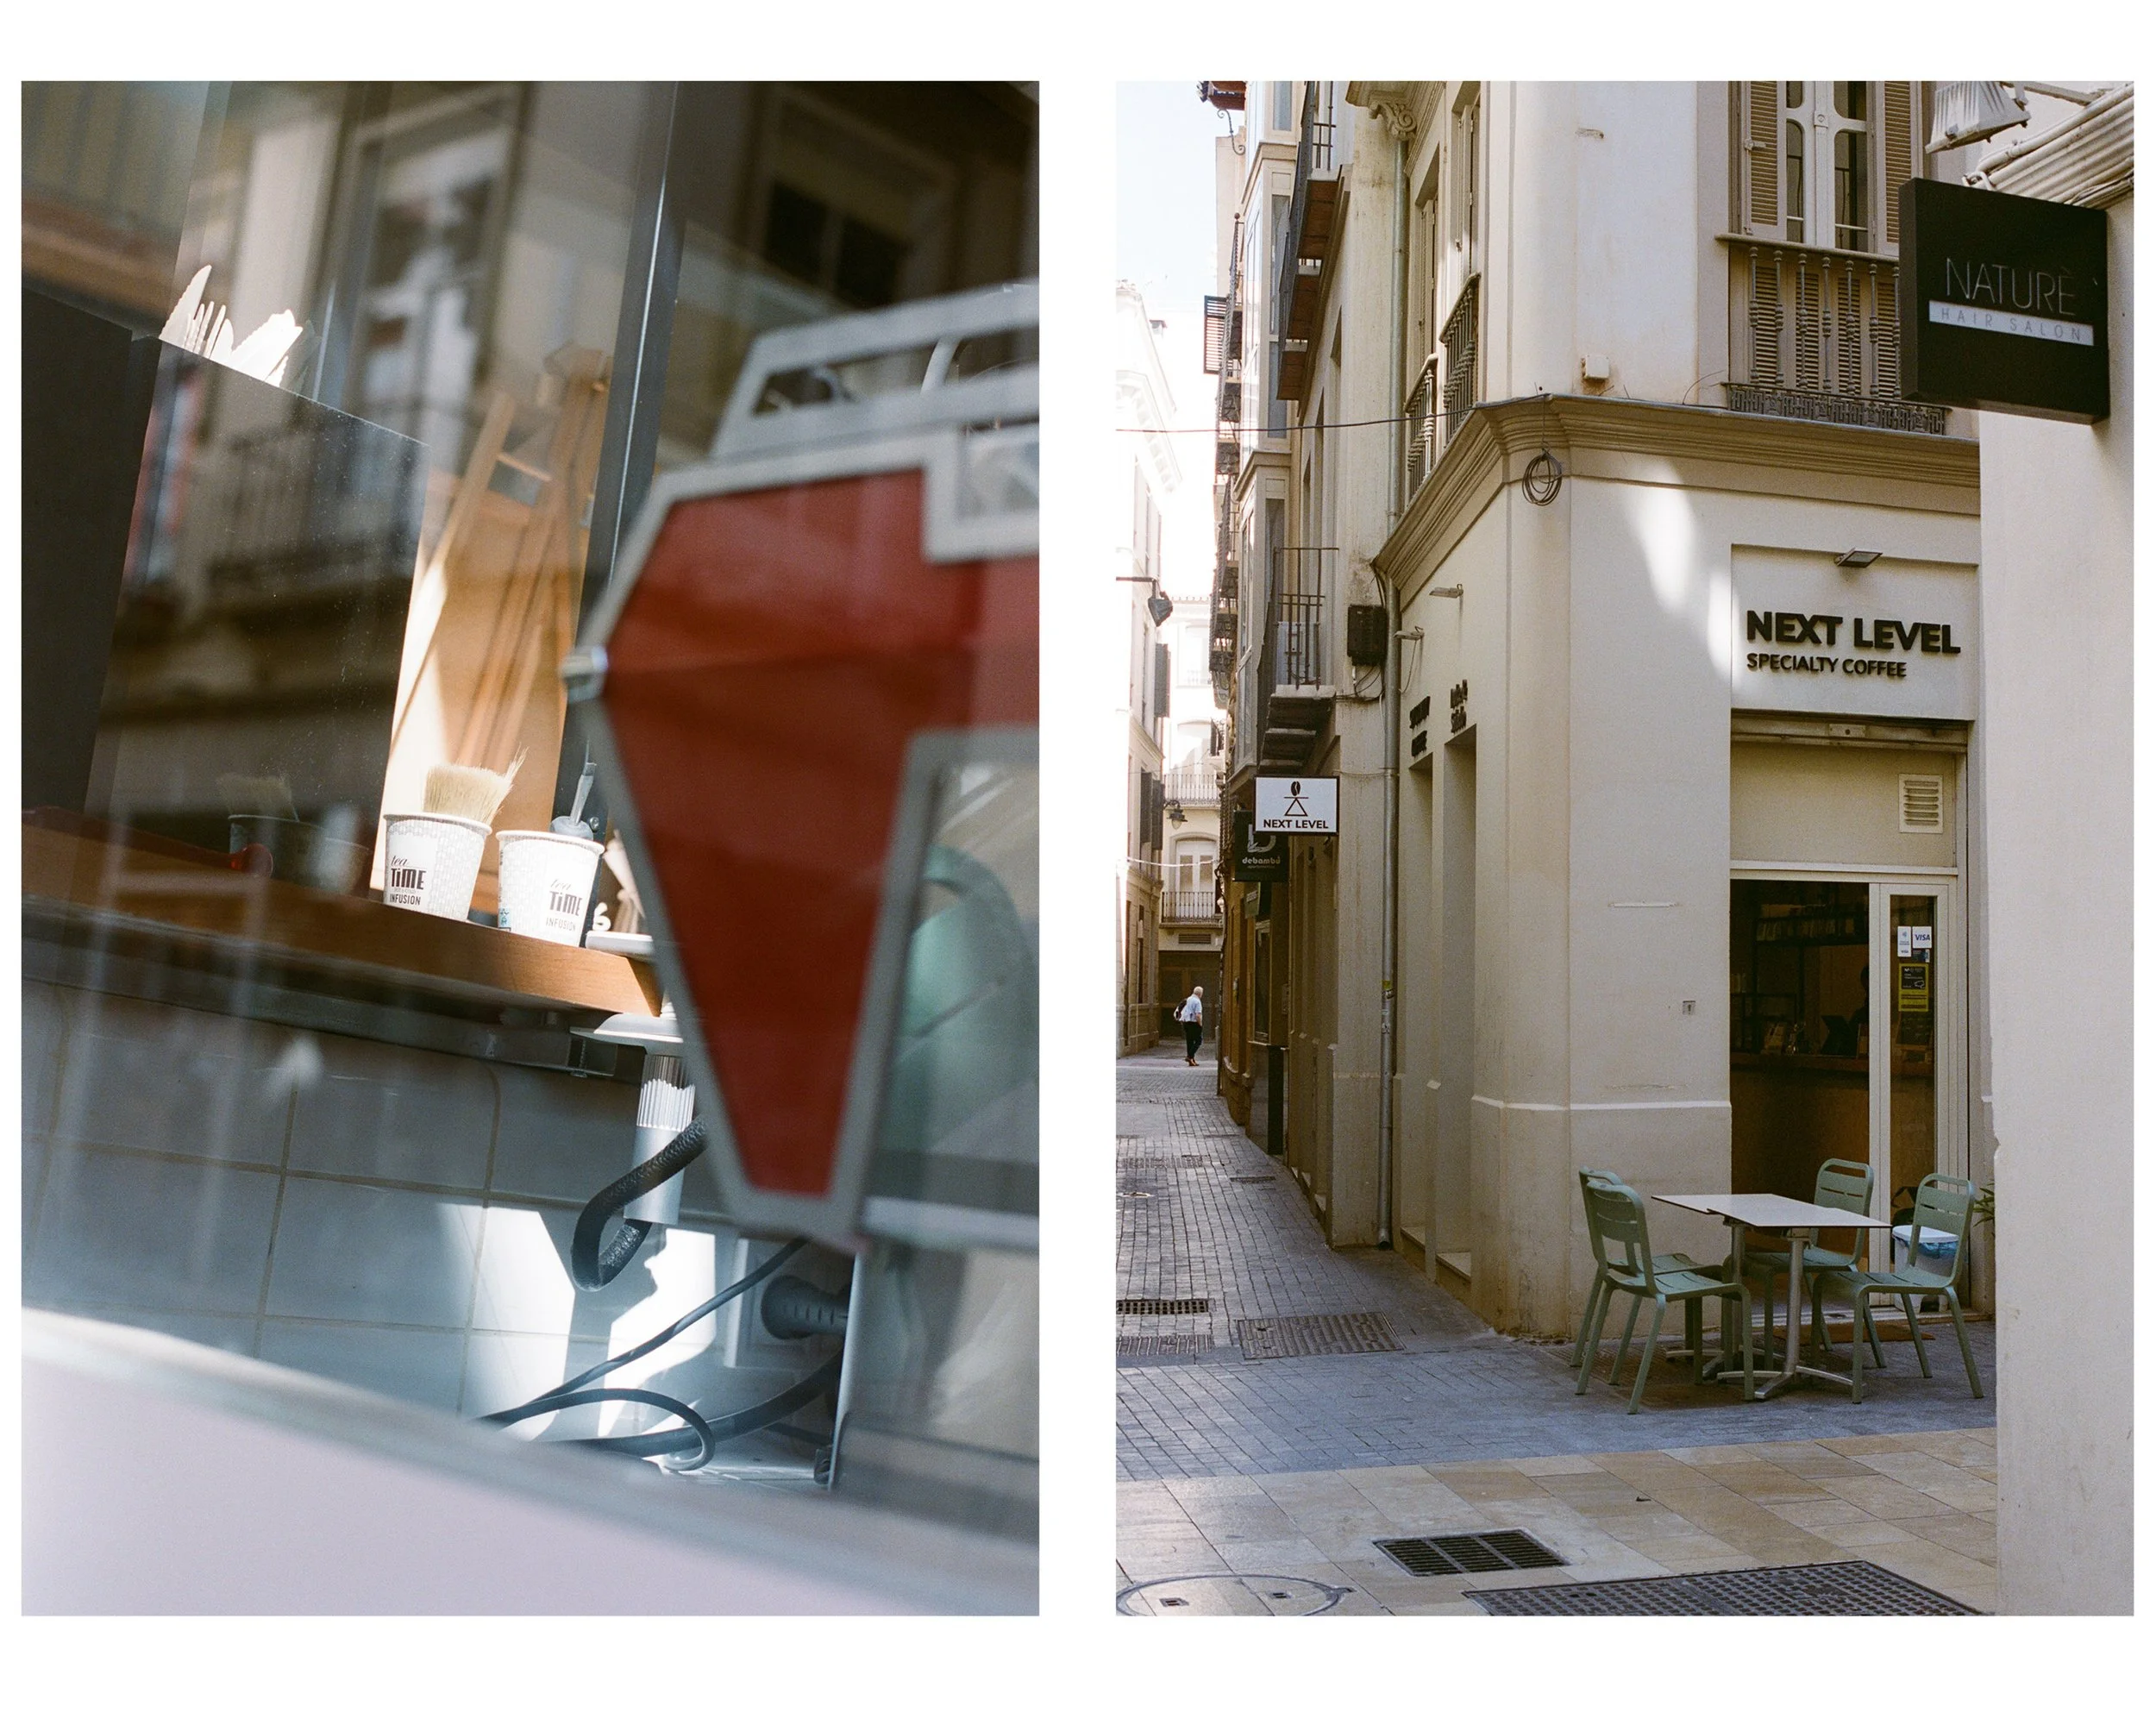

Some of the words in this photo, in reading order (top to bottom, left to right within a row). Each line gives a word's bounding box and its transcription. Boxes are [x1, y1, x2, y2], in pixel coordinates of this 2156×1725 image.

[1941, 307, 1993, 328] HAIR
[2009, 317, 2081, 342] SALON
[1746, 610, 1843, 646] NEXT
[1853, 618, 1962, 654] LEVEL
[1746, 653, 1839, 673] SPECIALTY
[1842, 658, 1908, 678] COFFEE
[1263, 819, 1292, 828] NEXT
[1295, 819, 1329, 829] LEVEL
[390, 894, 422, 906] INFUSION
[546, 917, 576, 932] INFUSION
